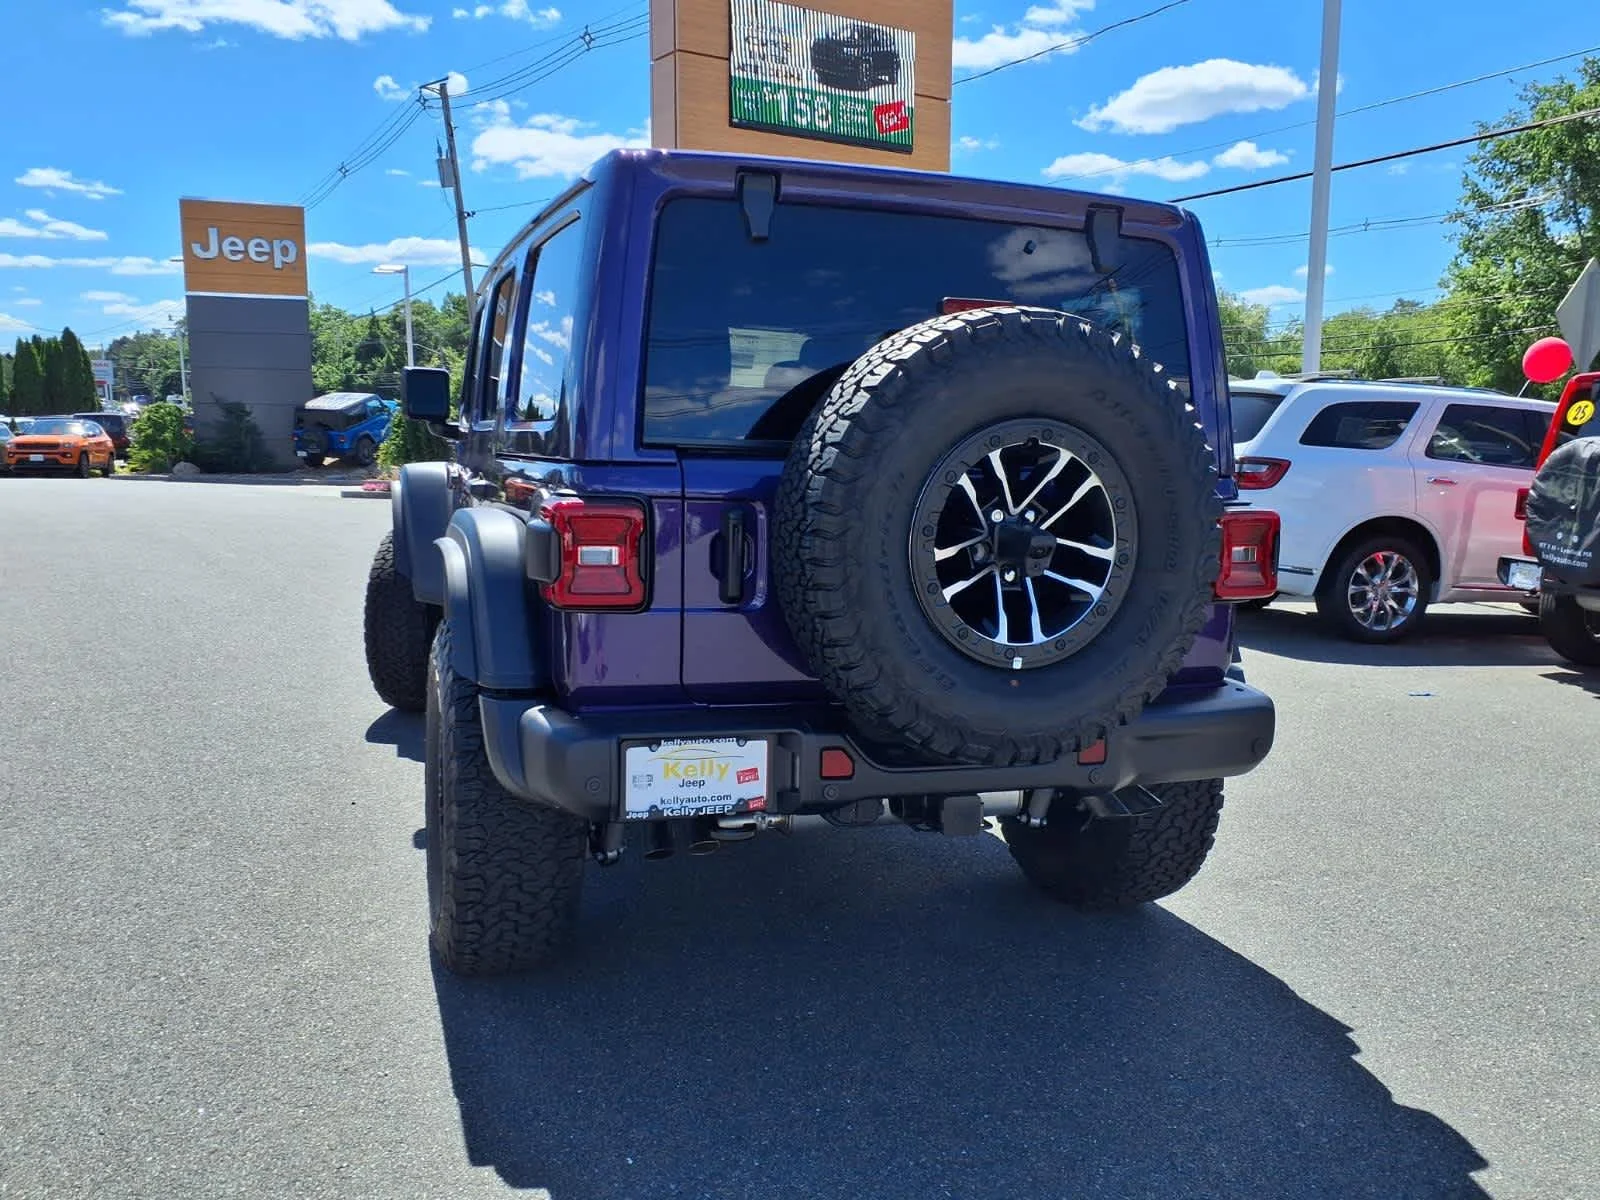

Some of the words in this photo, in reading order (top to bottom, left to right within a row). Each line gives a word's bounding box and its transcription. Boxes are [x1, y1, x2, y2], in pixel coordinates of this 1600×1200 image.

[191, 227, 298, 269] Jeep
[1573, 404, 1589, 421] 25
[661, 737, 737, 747] kellyauto.com
[663, 759, 730, 783] Kelly
[678, 778, 706, 789] Jeep
[660, 794, 732, 806] kellyauto.com
[626, 811, 650, 820] Jeep
[663, 806, 697, 817] Kelly
[698, 805, 733, 815] JEEP
